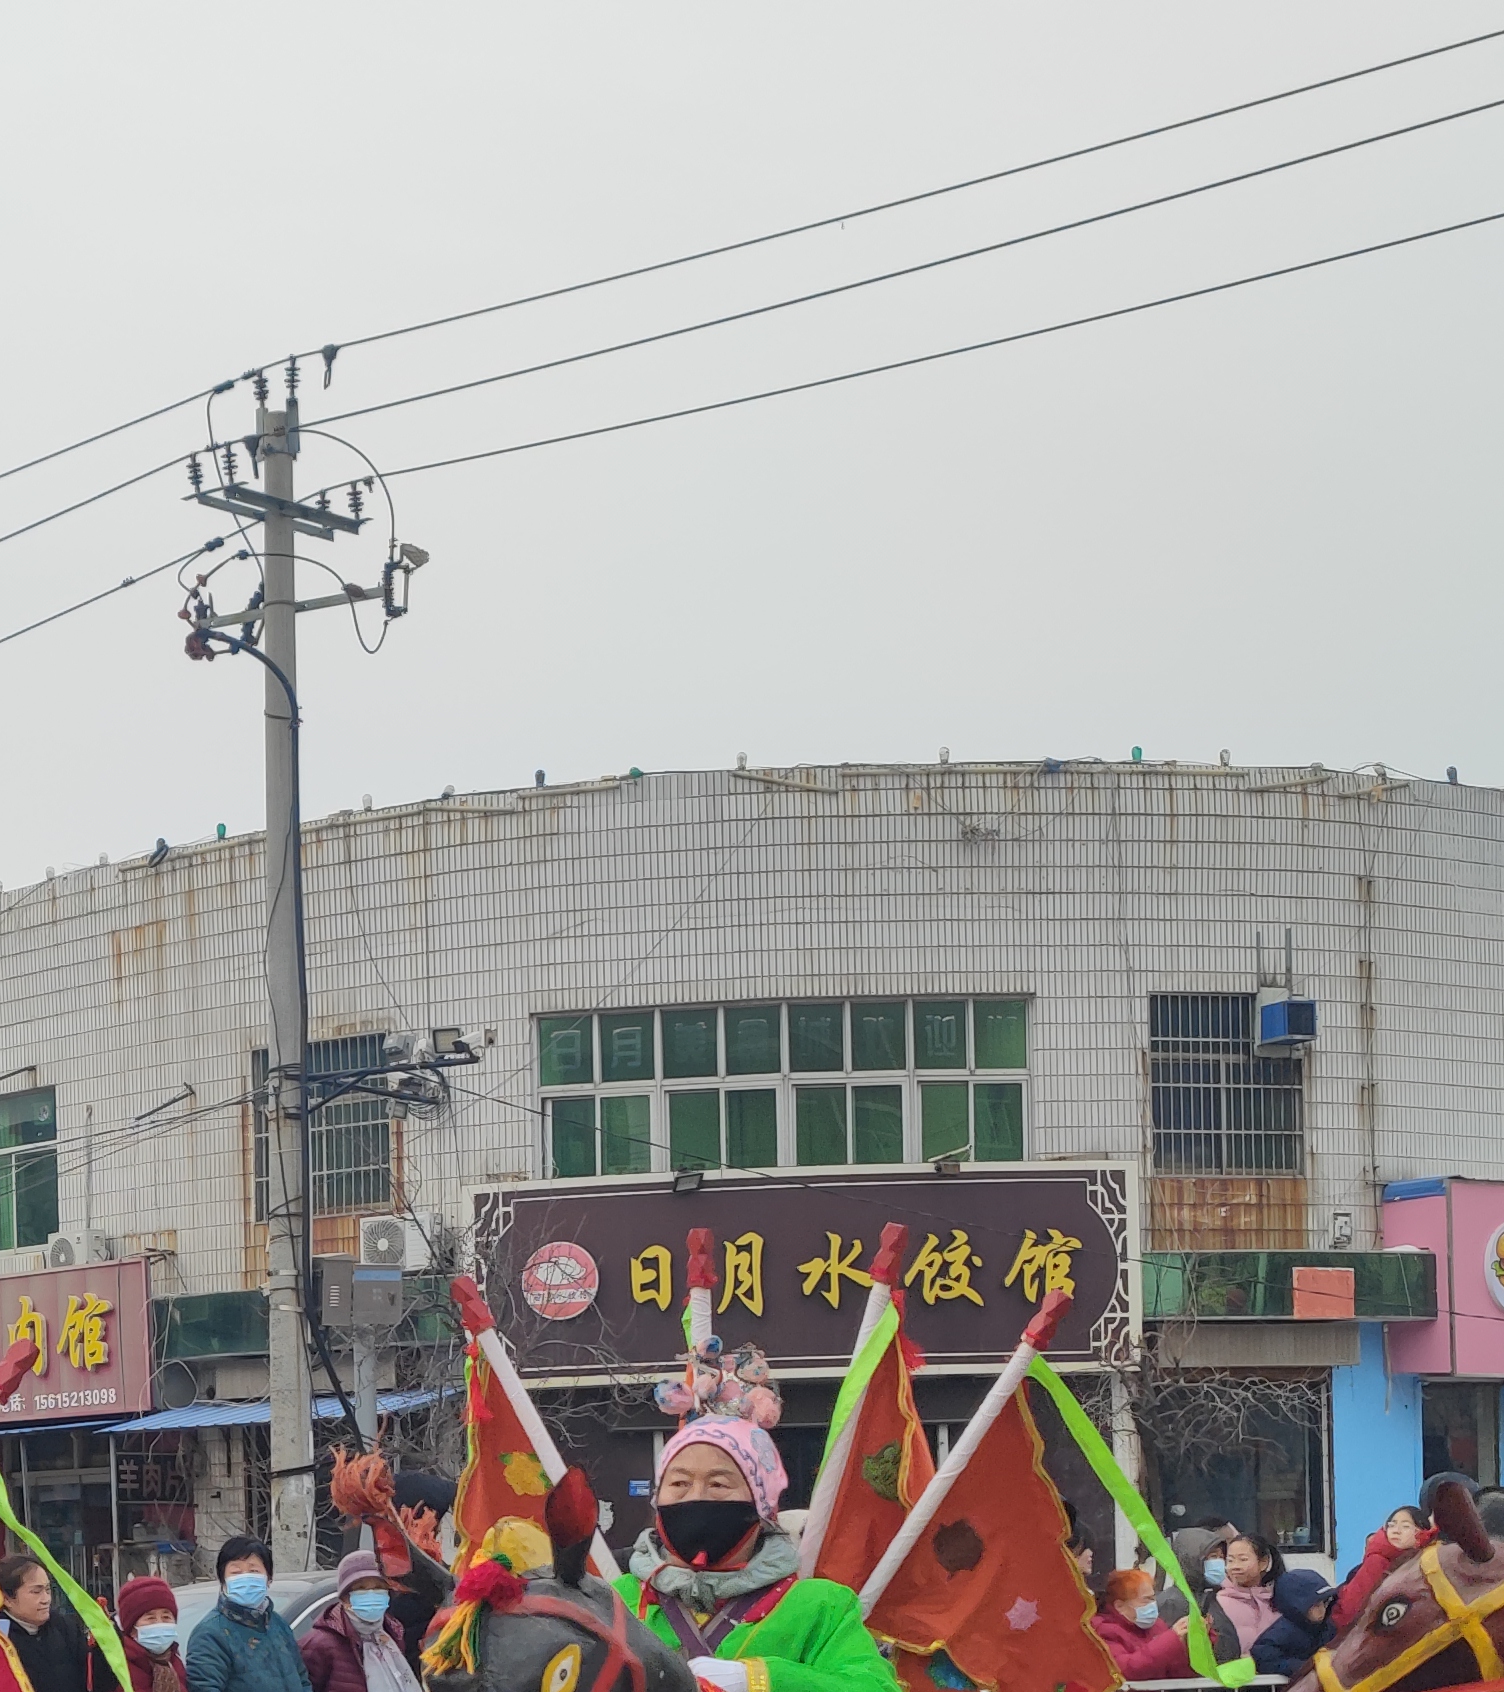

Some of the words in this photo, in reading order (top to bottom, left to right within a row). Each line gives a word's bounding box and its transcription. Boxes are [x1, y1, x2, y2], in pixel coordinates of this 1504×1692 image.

[629, 1229, 1083, 1316] 日月水饺馆
[33, 1387, 118, 1411] 15615213098
